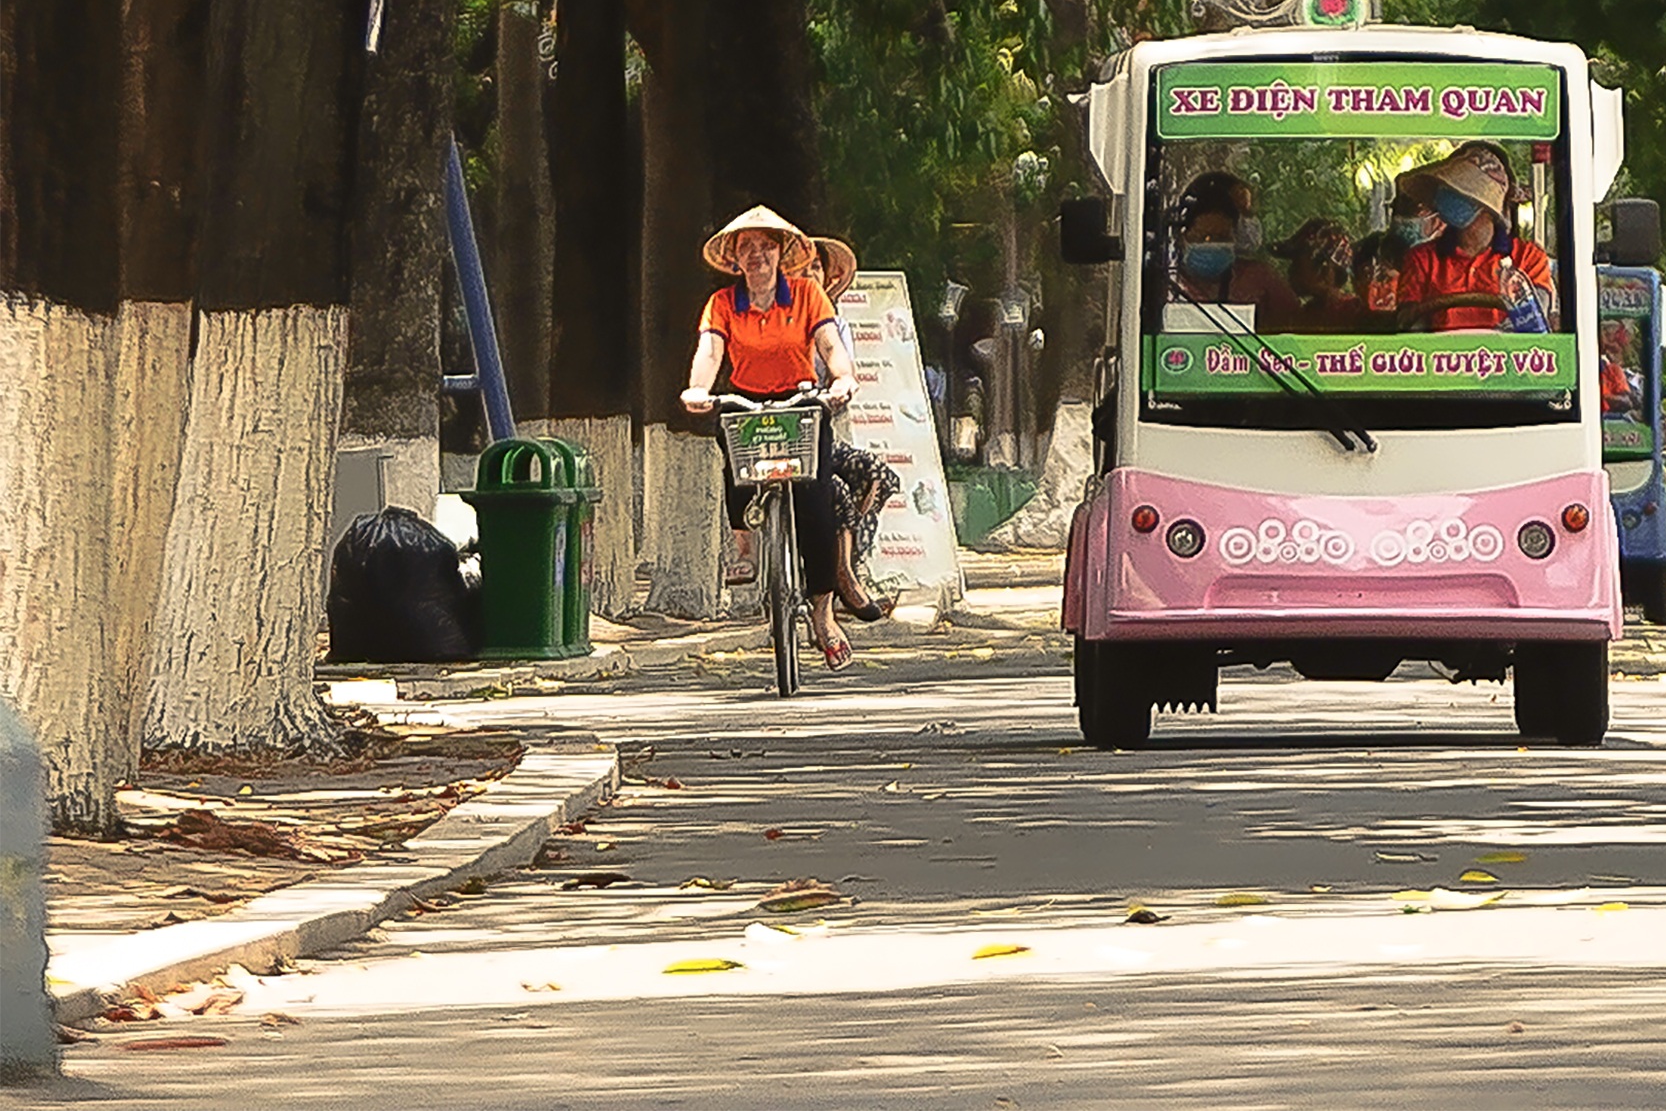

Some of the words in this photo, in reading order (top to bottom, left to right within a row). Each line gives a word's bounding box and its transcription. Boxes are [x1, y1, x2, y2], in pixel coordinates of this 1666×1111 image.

[1170, 87, 1221, 115] XE
[1228, 79, 1318, 120] ĐIỆN
[1327, 87, 1433, 114] THAM
[1440, 87, 1547, 119] QUAN
[1315, 342, 1365, 375] THẾ
[1371, 346, 1426, 374] GIỚI
[1432, 345, 1507, 380] TUYỆT
[1512, 346, 1558, 375] VỜI
